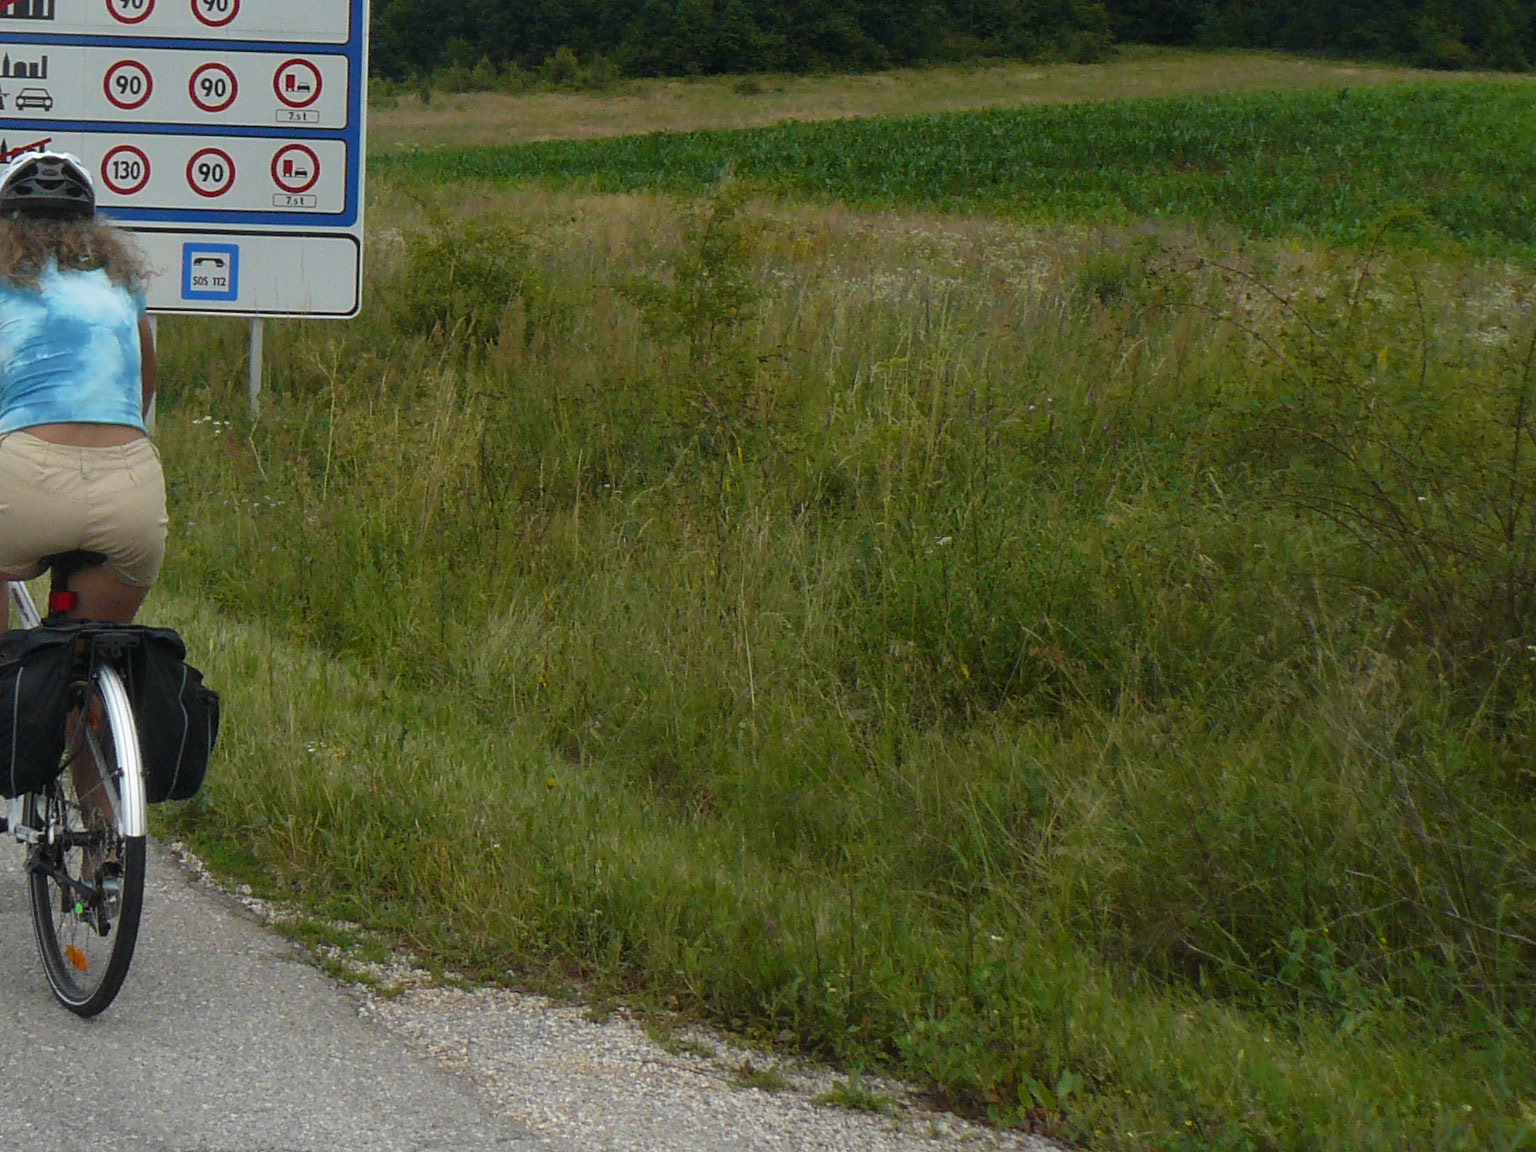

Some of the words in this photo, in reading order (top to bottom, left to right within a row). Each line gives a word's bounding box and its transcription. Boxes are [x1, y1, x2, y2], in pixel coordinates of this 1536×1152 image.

[115, 75, 141, 95] 90
[200, 78, 226, 97] 90
[112, 160, 141, 180] 130
[198, 163, 224, 183] 90
[192, 276, 209, 286] SOS
[213, 277, 226, 287] 112
